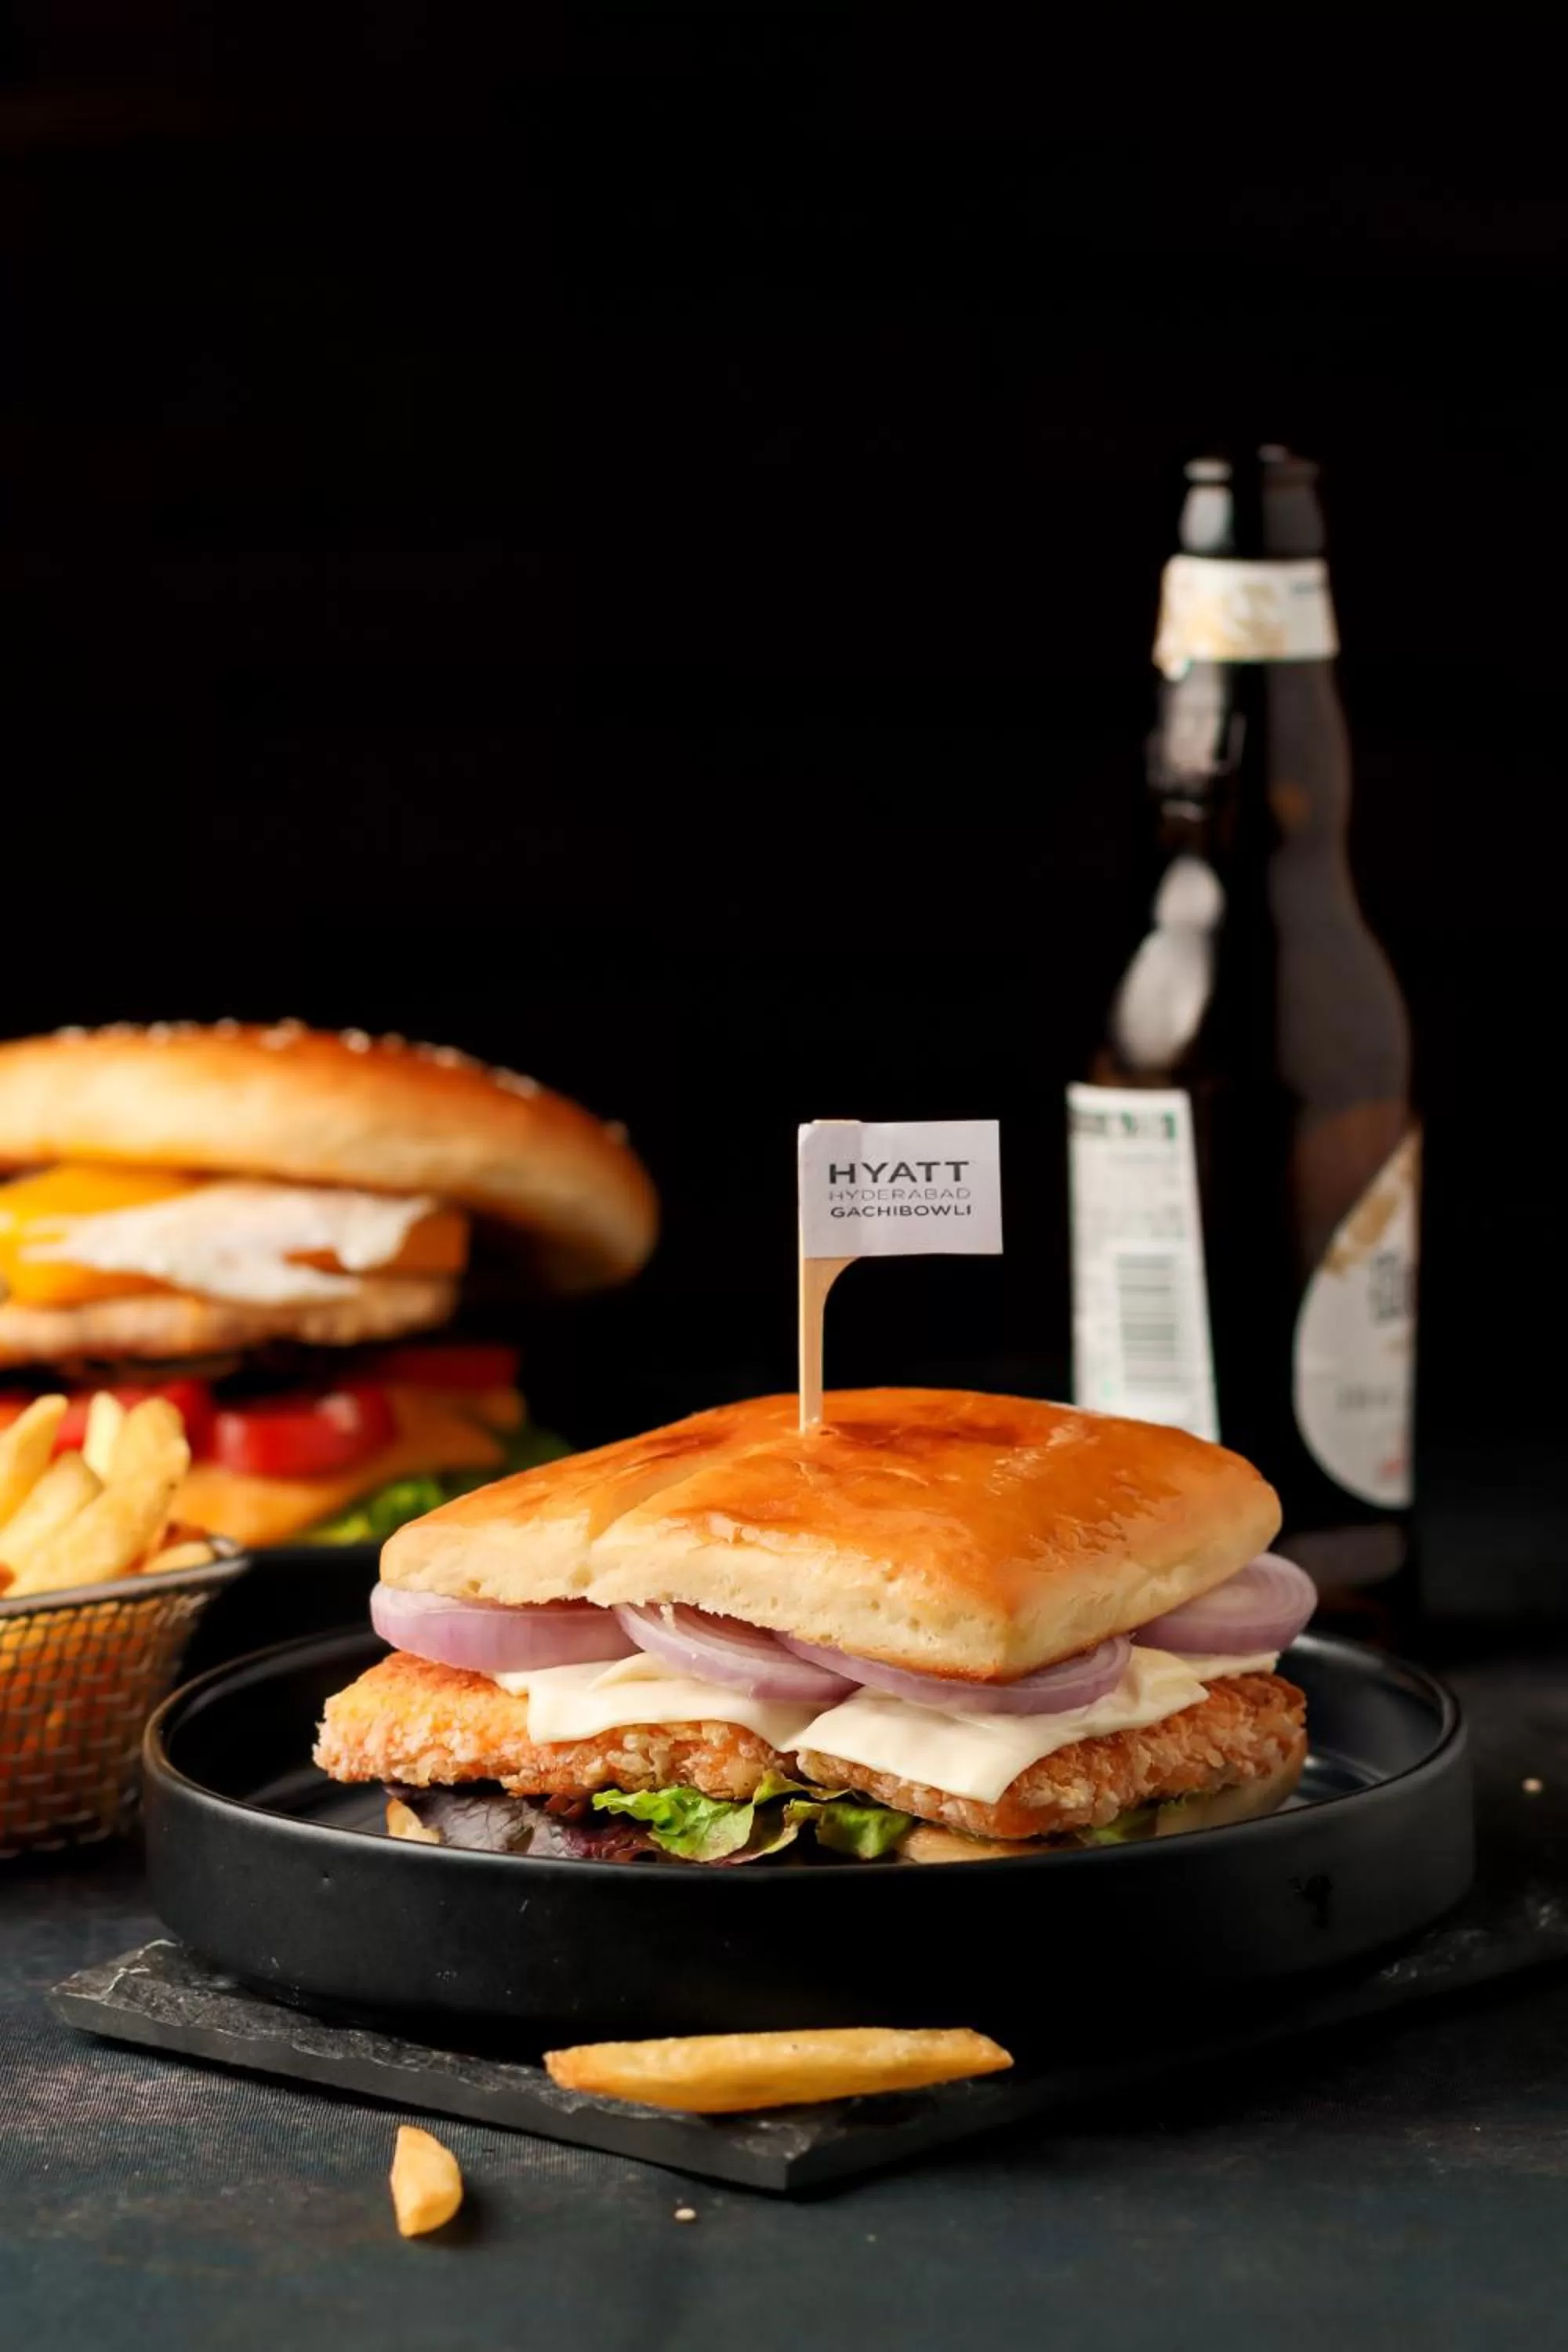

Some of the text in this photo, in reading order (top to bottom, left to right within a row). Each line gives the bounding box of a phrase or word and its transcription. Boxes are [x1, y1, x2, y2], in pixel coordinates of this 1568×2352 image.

[829, 1160, 970, 1185] HYATT
[829, 1187, 971, 1201] HYDERABAD
[829, 1204, 972, 1218] GACHIBOWLI
